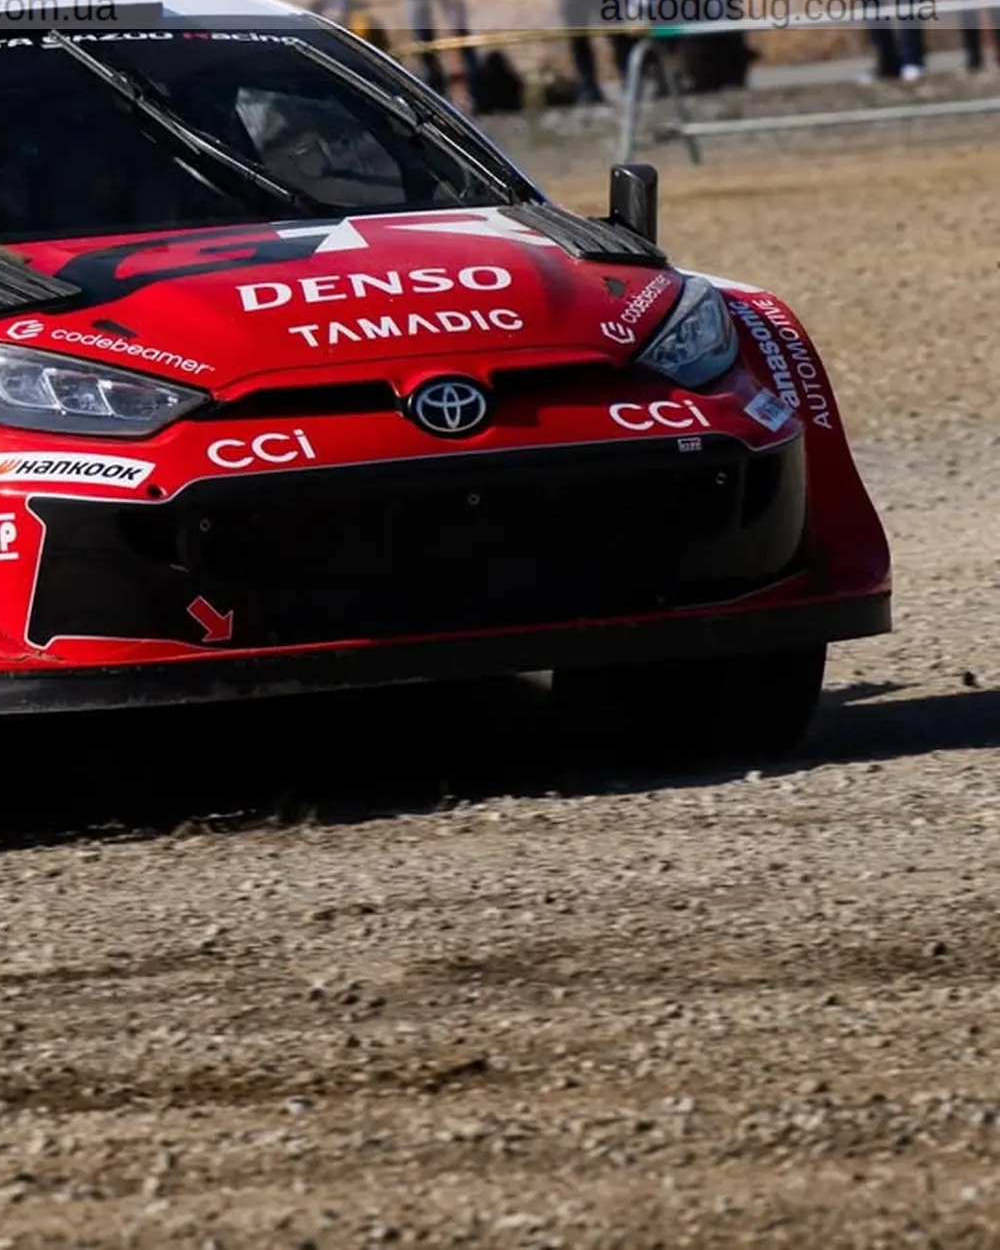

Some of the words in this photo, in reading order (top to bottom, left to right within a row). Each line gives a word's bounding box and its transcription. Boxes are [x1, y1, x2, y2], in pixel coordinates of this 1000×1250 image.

[236, 266, 512, 312] DENSO
[51, 327, 210, 376] codebeamer
[288, 309, 524, 348] TAMADIC
[728, 301, 801, 410] anasonic
[752, 298, 833, 430] AUTOMOTIVE
